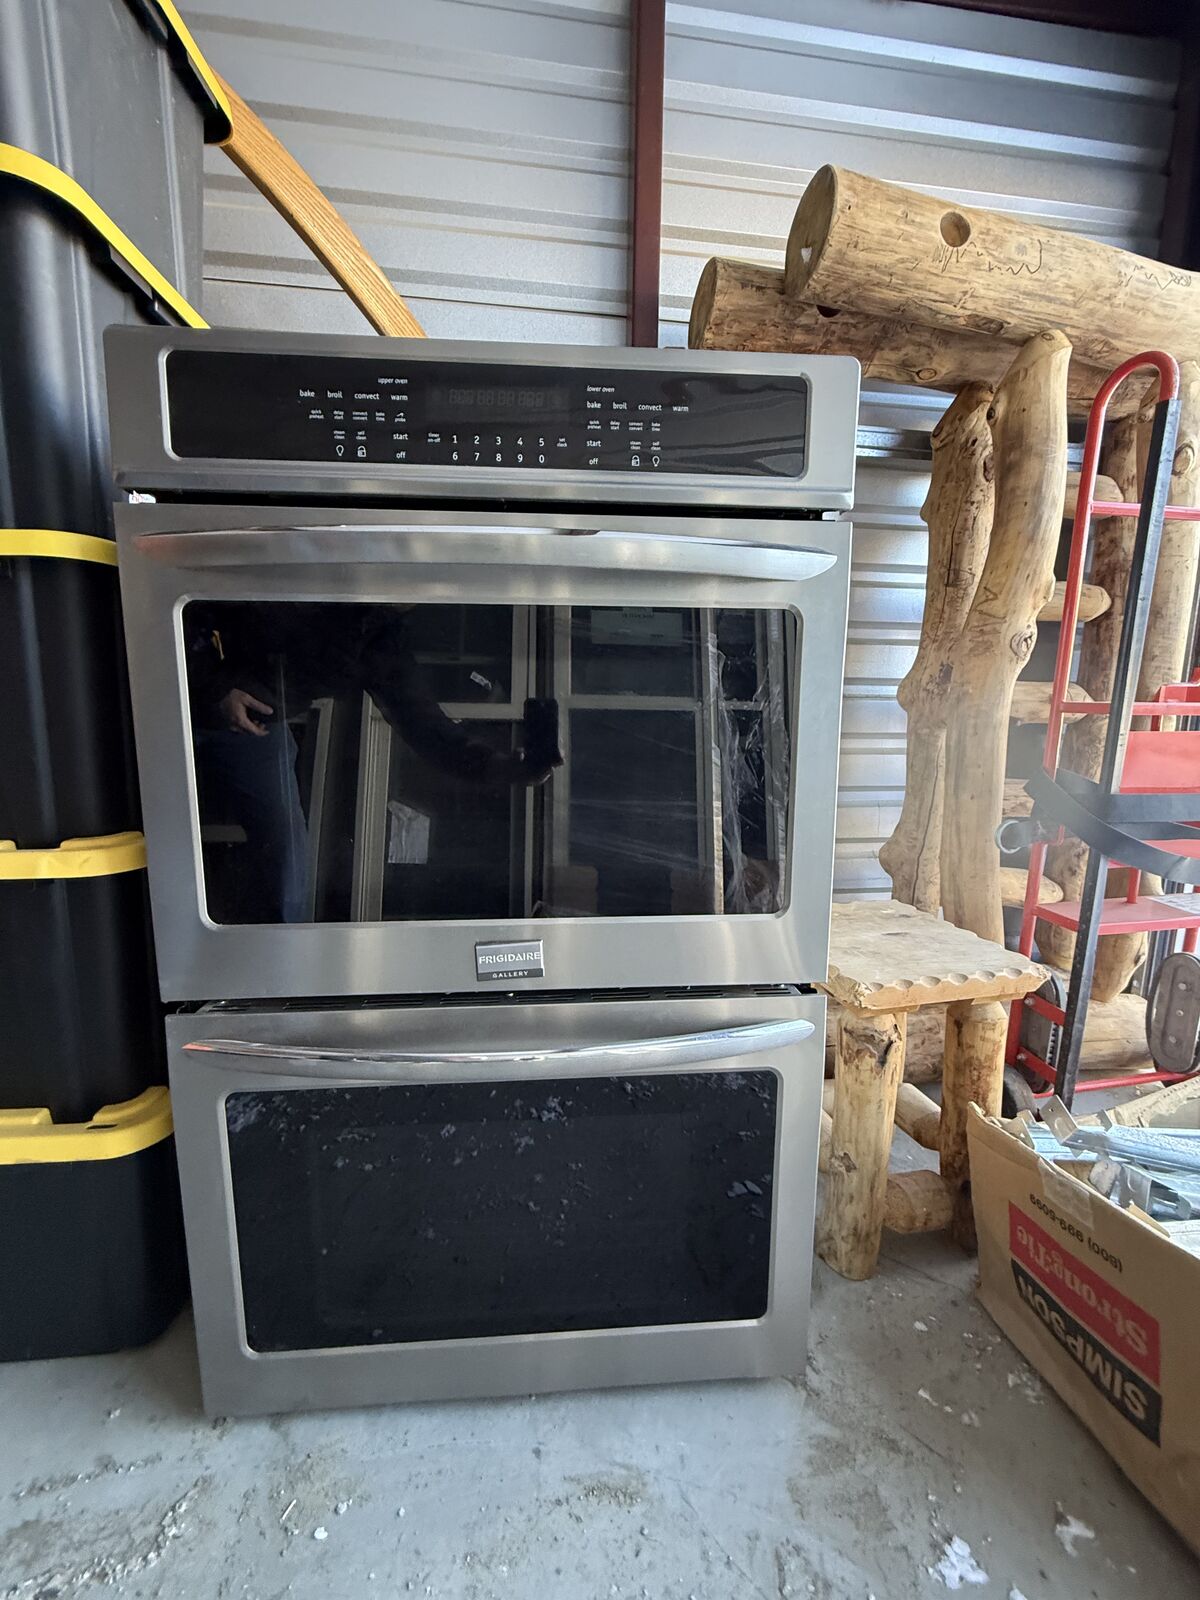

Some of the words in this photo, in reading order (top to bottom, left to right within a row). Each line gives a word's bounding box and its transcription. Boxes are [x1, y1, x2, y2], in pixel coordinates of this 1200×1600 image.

[378, 377, 394, 385] upper
[299, 389, 315, 397] bake
[327, 390, 343, 398] broil
[354, 392, 380, 400] convect
[586, 401, 602, 409] bake
[612, 402, 628, 410] broil
[452, 434, 458, 444] 1
[474, 435, 480, 444] 2
[496, 436, 502, 446] 3
[517, 437, 523, 446] 4
[539, 438, 545, 446] 5
[396, 451, 406, 459] off
[452, 452, 458, 460] 6
[474, 452, 480, 461] 7
[496, 453, 502, 462] 8
[517, 454, 524, 463] 9
[538, 454, 545, 464] 0
[588, 458, 599, 466] off
[479, 951, 542, 964] FRIGIDAIRE
[492, 970, 529, 978] GALLERY
[1029, 1193, 1085, 1244] 999-5099
[1087, 1234, 1124, 1273] (800)
[1016, 1225, 1149, 1356] Strong-Tie
[1017, 1273, 1149, 1421] SIMPSON
